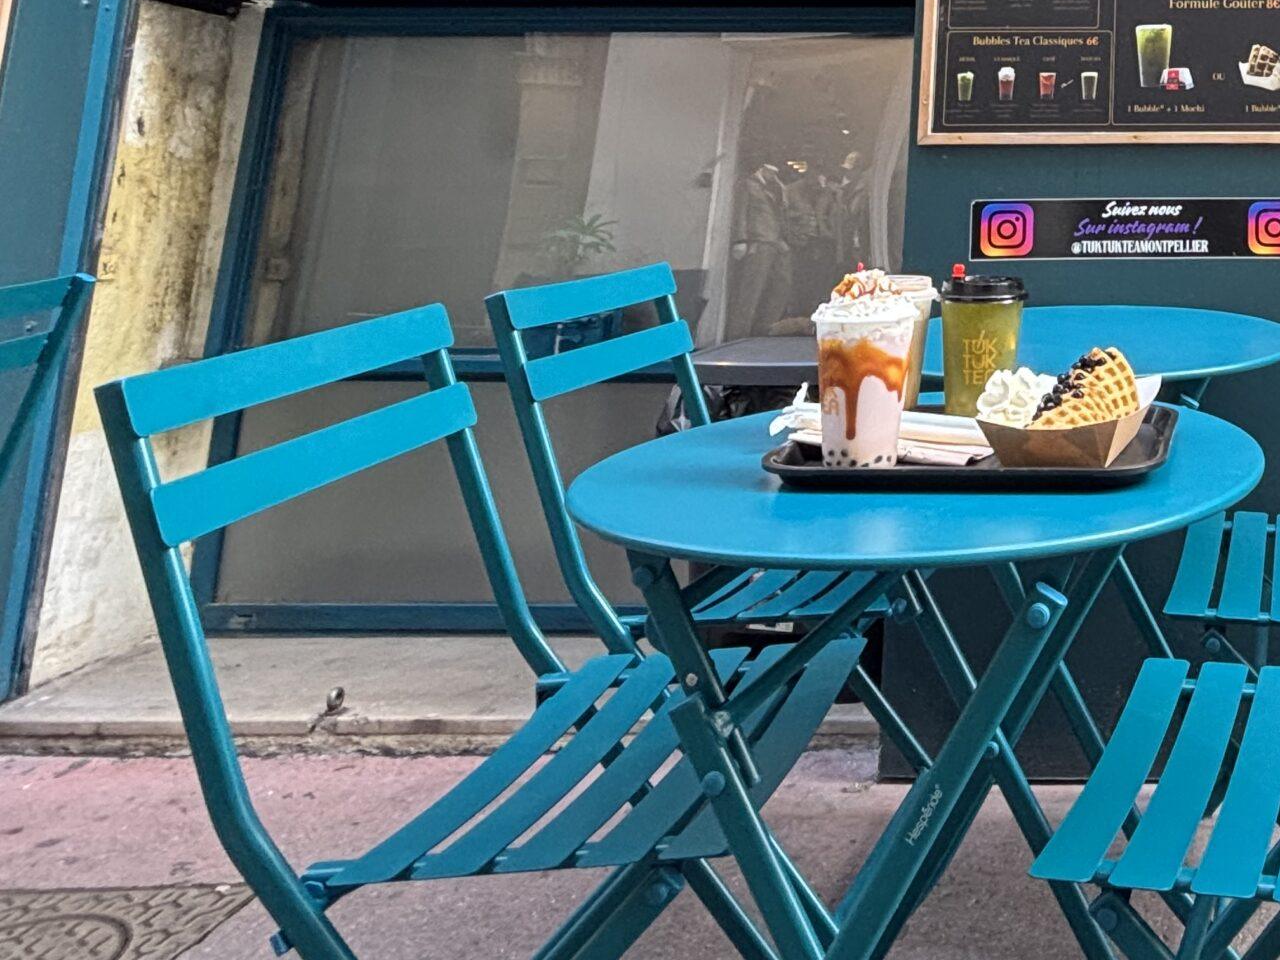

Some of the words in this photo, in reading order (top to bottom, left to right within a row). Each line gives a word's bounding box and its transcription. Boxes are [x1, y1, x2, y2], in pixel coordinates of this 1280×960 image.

[972, 35, 1011, 46] Bubbles
[1012, 35, 1031, 46] Tea
[1033, 35, 1084, 48] Classiques
[1085, 36, 1099, 46] 6€
[1102, 201, 1148, 218] Suivez
[1148, 205, 1182, 216] nous
[1074, 218, 1106, 236] Sur
[1107, 219, 1190, 240] instagram
[1071, 240, 1209, 254] @TUKTUKTEAMONTPELLIER
[963, 330, 998, 354] TUK
[963, 353, 997, 370] TUK
